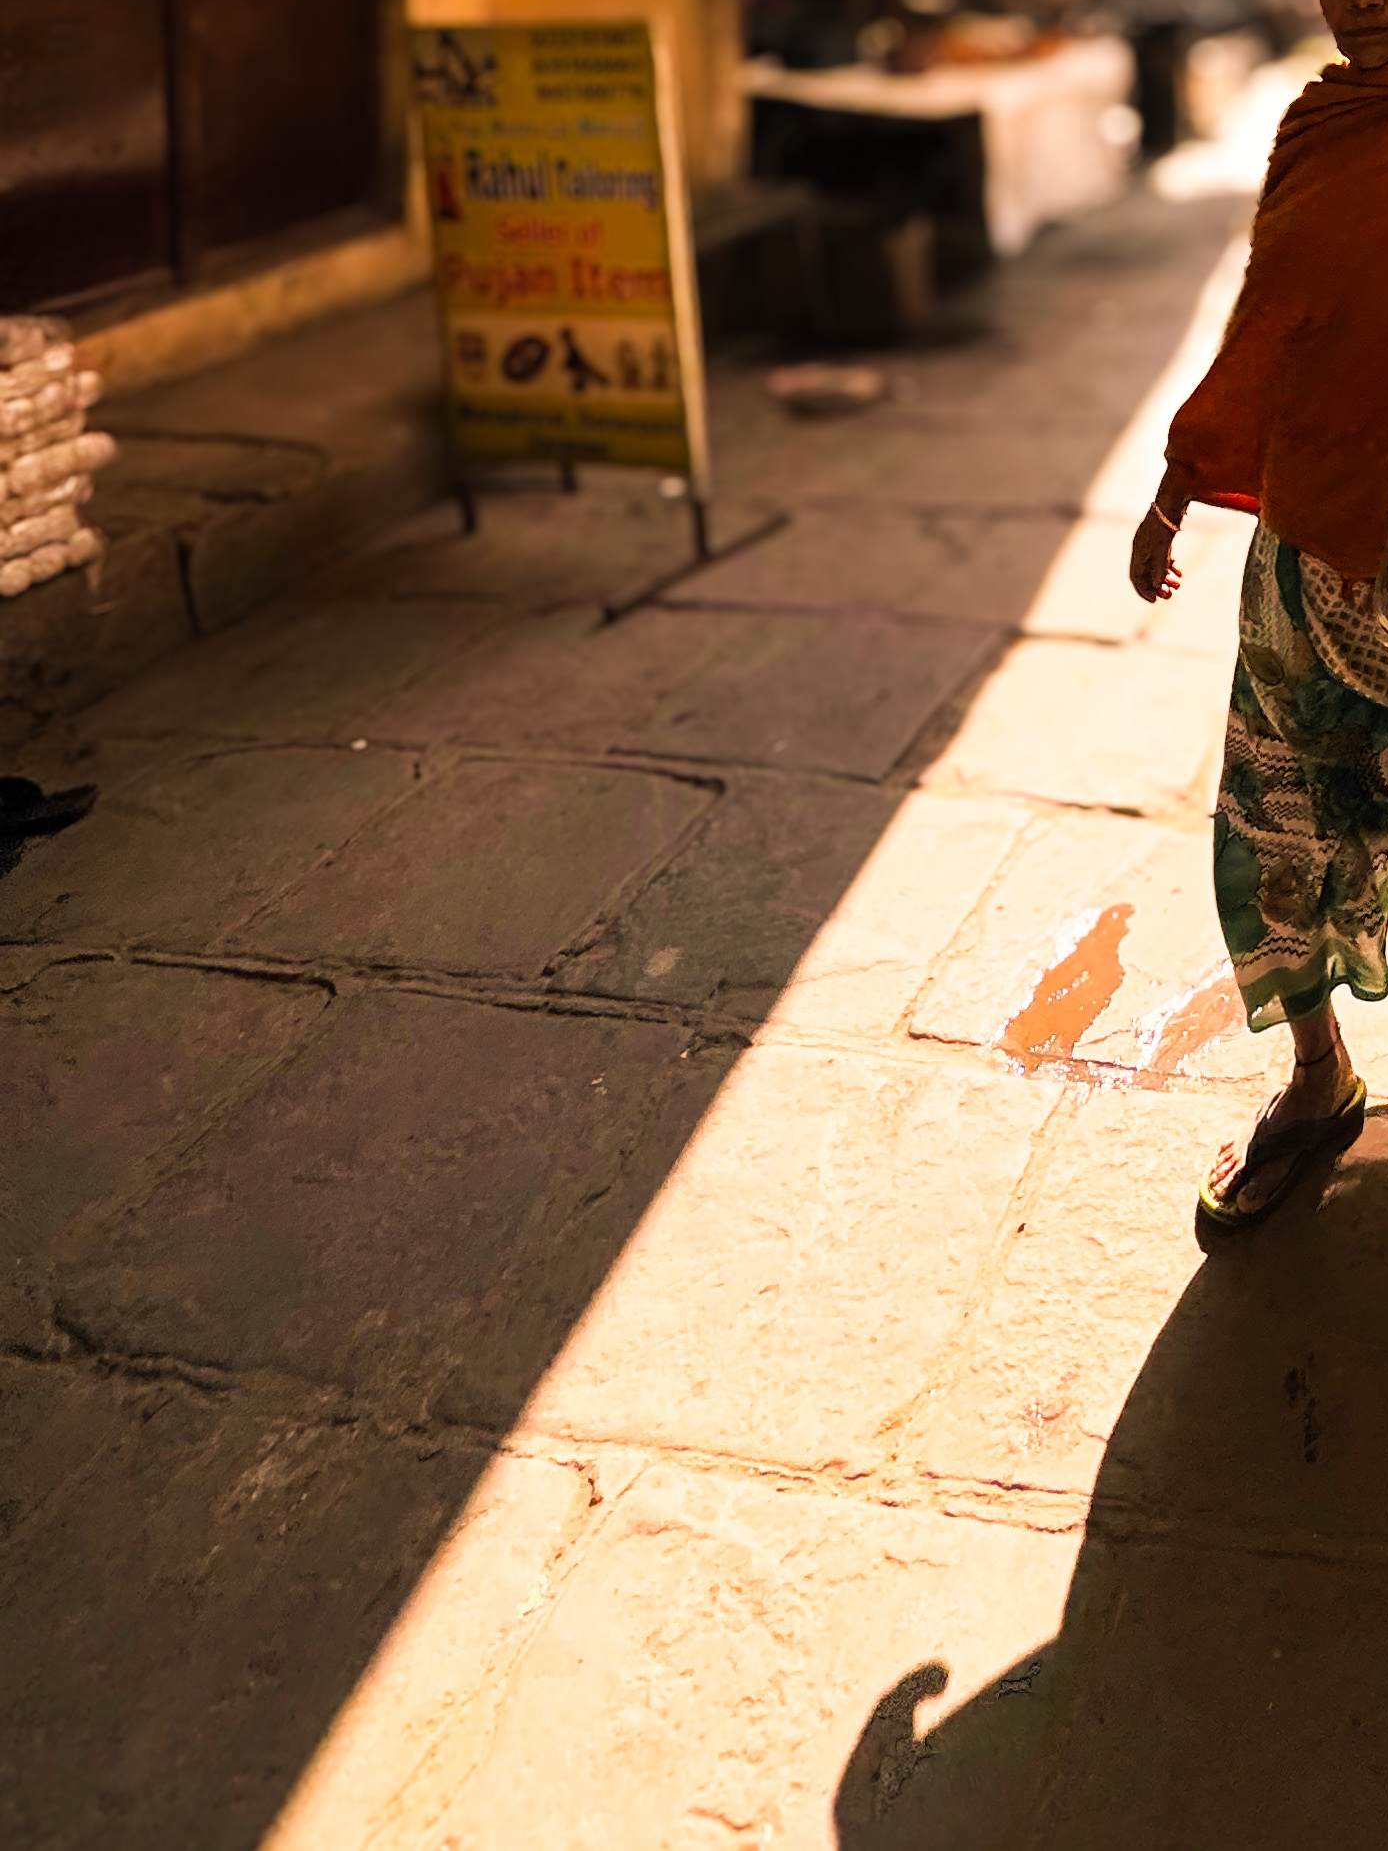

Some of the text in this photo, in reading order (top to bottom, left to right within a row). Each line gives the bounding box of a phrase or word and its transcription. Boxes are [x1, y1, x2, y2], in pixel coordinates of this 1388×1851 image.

[464, 149, 659, 212] Rahul Tailoring
[496, 216, 602, 248] Seller of
[445, 255, 555, 307] Pujan
